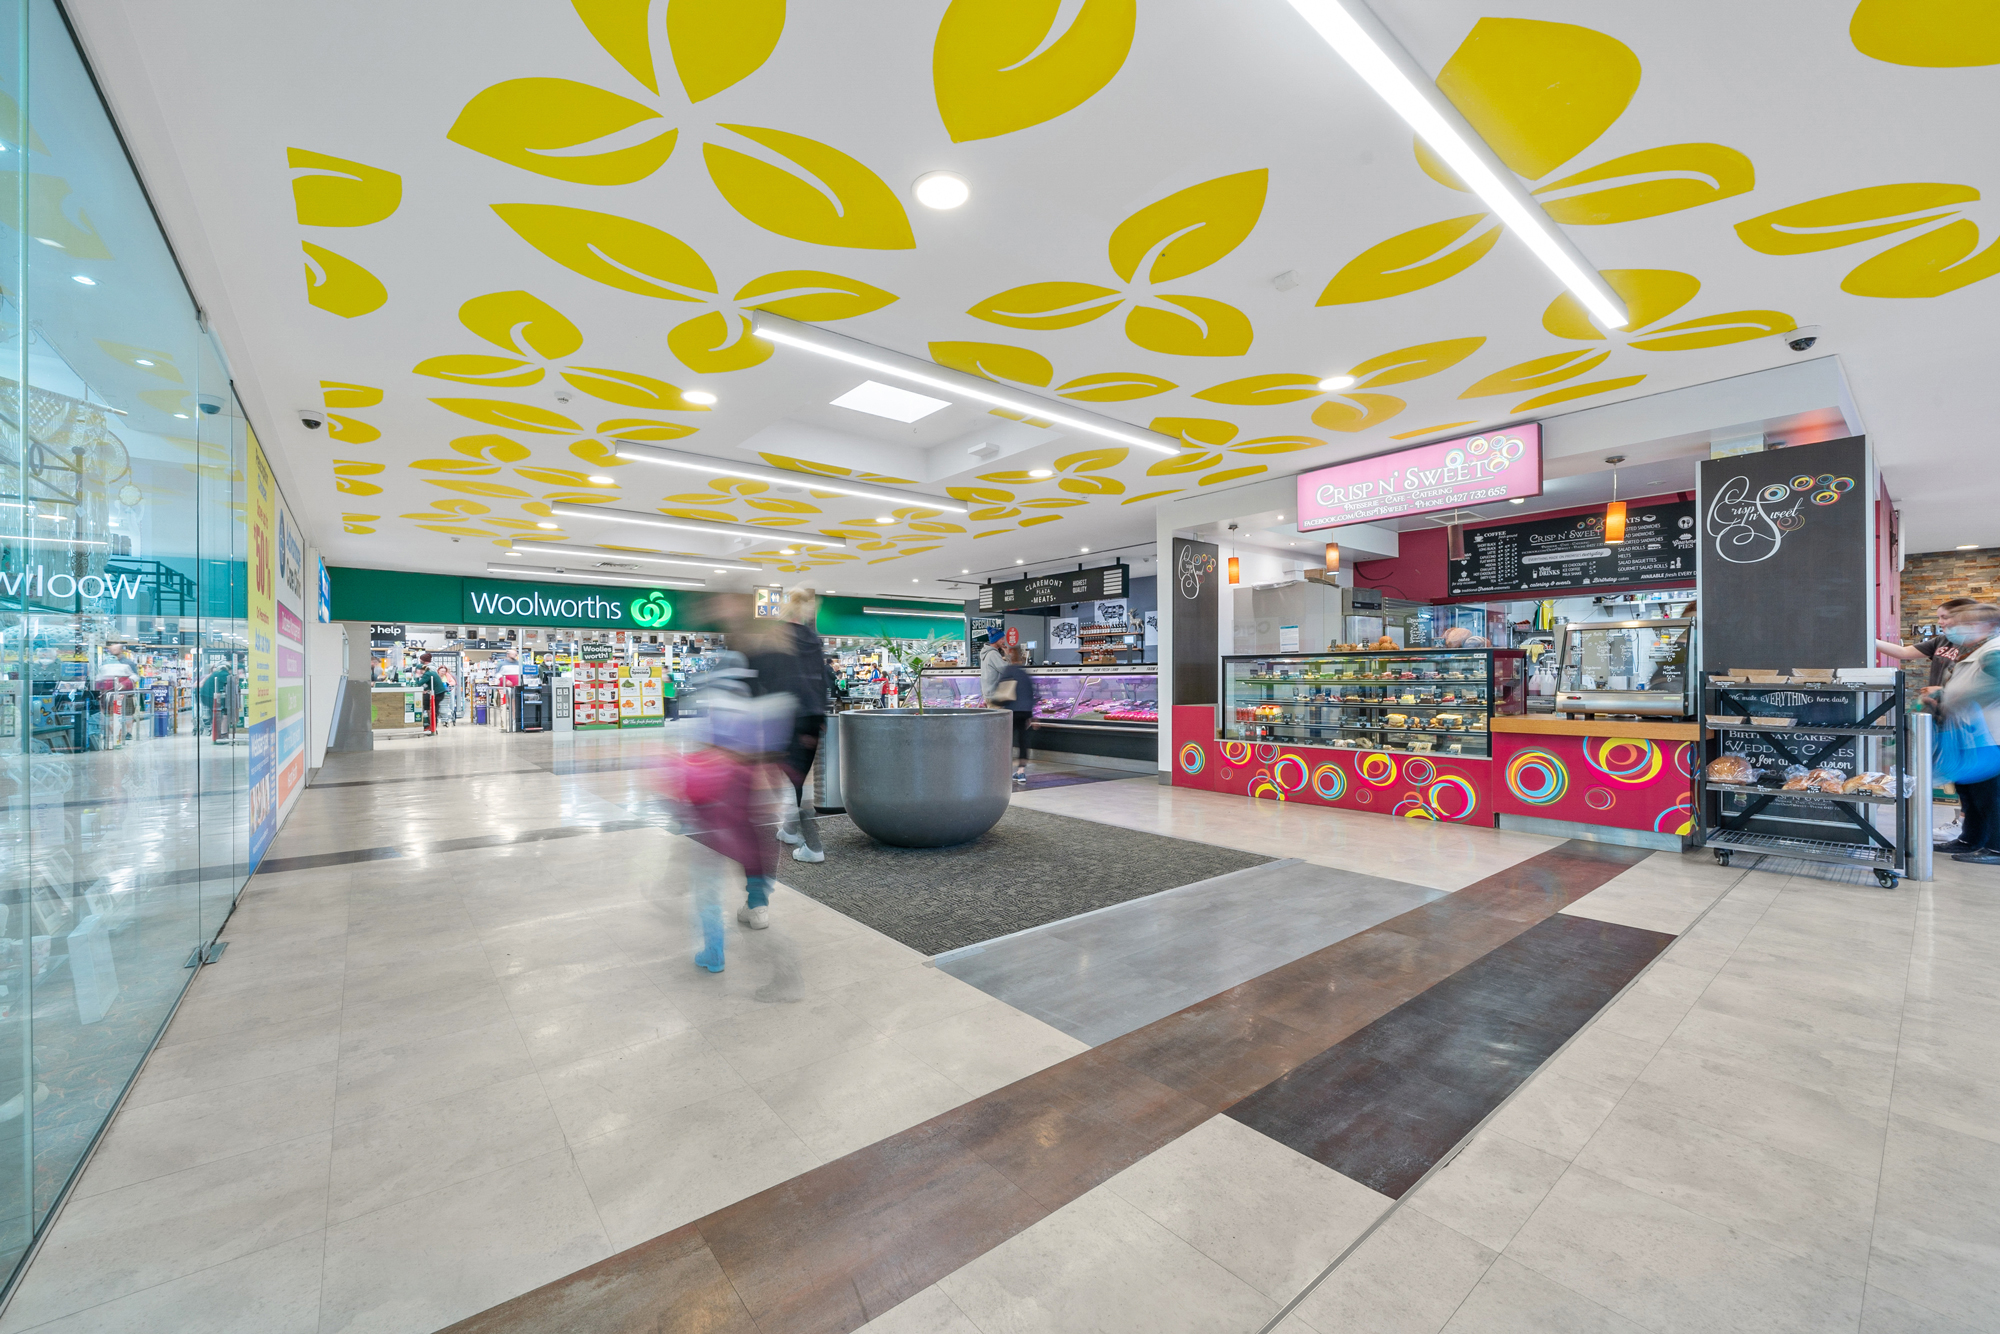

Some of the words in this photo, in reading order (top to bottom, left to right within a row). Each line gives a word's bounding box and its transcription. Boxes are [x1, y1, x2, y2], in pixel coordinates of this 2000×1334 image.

[1316, 482, 1373, 505] CRISP
[1404, 460, 1488, 490] SWEET
[1446, 493, 1467, 504] 0427
[1469, 490, 1486, 499] 732
[1488, 486, 1507, 497] 655
[1530, 534, 1556, 543] CRISP
[1025, 579, 1062, 592] CLAREMONT
[1072, 586, 1088, 594] QUALITY
[1033, 595, 1054, 604] MEATS
[470, 592, 622, 621] Woolworths
[377, 626, 402, 636] help
[584, 652, 608, 660] worth!
[1760, 691, 1814, 708] EVERYTHING
[1831, 696, 1849, 704] daily
[1793, 733, 1836, 742] CAKES
[1756, 755, 1775, 767] for
